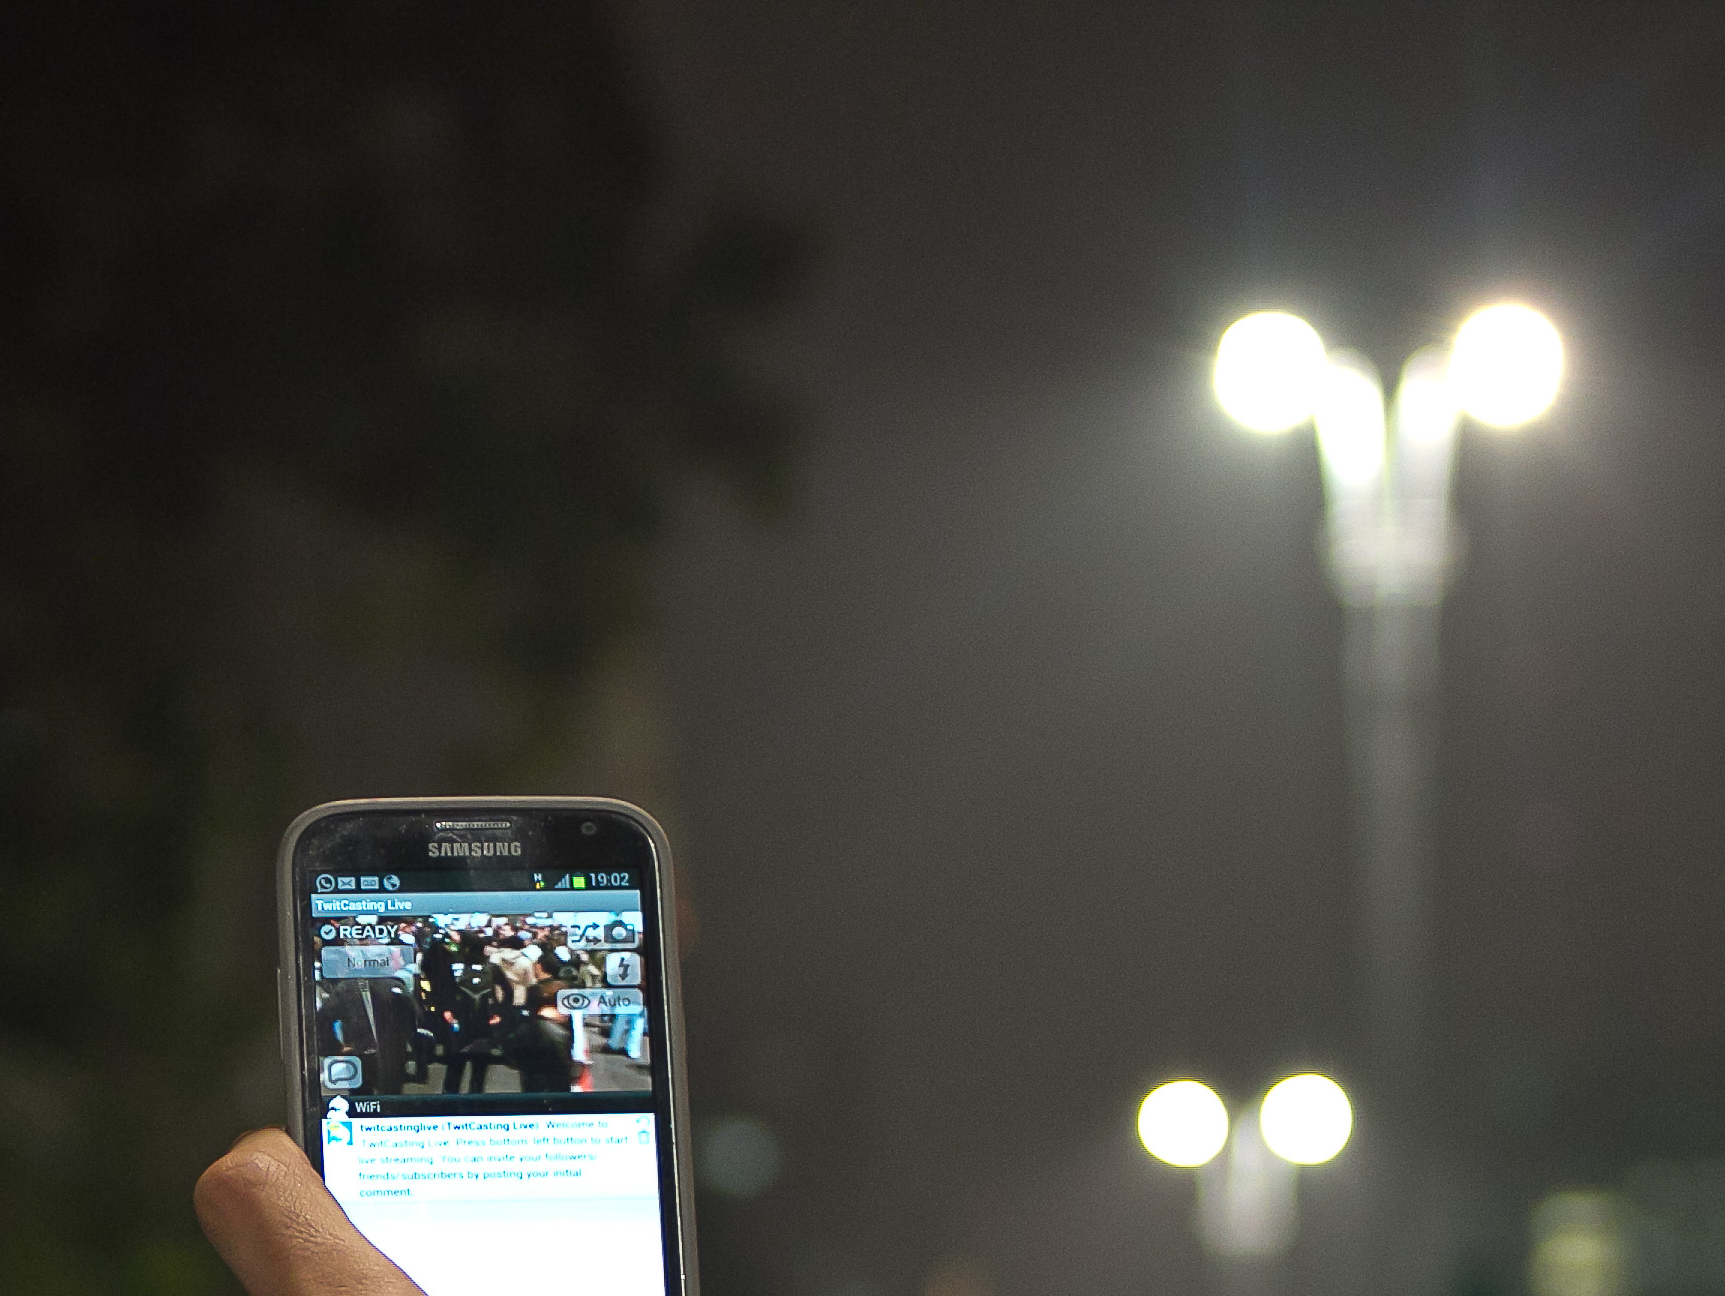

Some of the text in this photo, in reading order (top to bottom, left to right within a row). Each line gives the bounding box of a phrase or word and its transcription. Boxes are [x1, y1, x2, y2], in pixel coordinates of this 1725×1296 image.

[428, 842, 521, 857] SAMSUNG
[589, 872, 629, 886] 19:02
[315, 899, 412, 912] TwitCasting Live
[339, 925, 398, 939] READY
[347, 956, 389, 967] Normal
[597, 995, 631, 1007] Auto
[355, 1101, 380, 1112] WiFi
[360, 1122, 439, 1133] twitcastinglive
[442, 1121, 509, 1132] (TwitCasting
[546, 1120, 595, 1129] Welcome
[598, 1120, 608, 1129] to
[362, 1138, 425, 1149] TwitCasting
[456, 1138, 486, 1146] Press
[553, 1136, 588, 1145] button
[590, 1136, 601, 1144] to
[605, 1136, 628, 1144] start
[358, 1156, 376, 1164] live
[441, 1154, 461, 1163] You
[464, 1155, 484, 1163] can
[487, 1154, 515, 1162] invite
[519, 1154, 542, 1162] your
[467, 1170, 479, 1181] by
[483, 1170, 523, 1180] posting
[526, 1170, 549, 1180] your
[553, 1168, 582, 1177] initial
